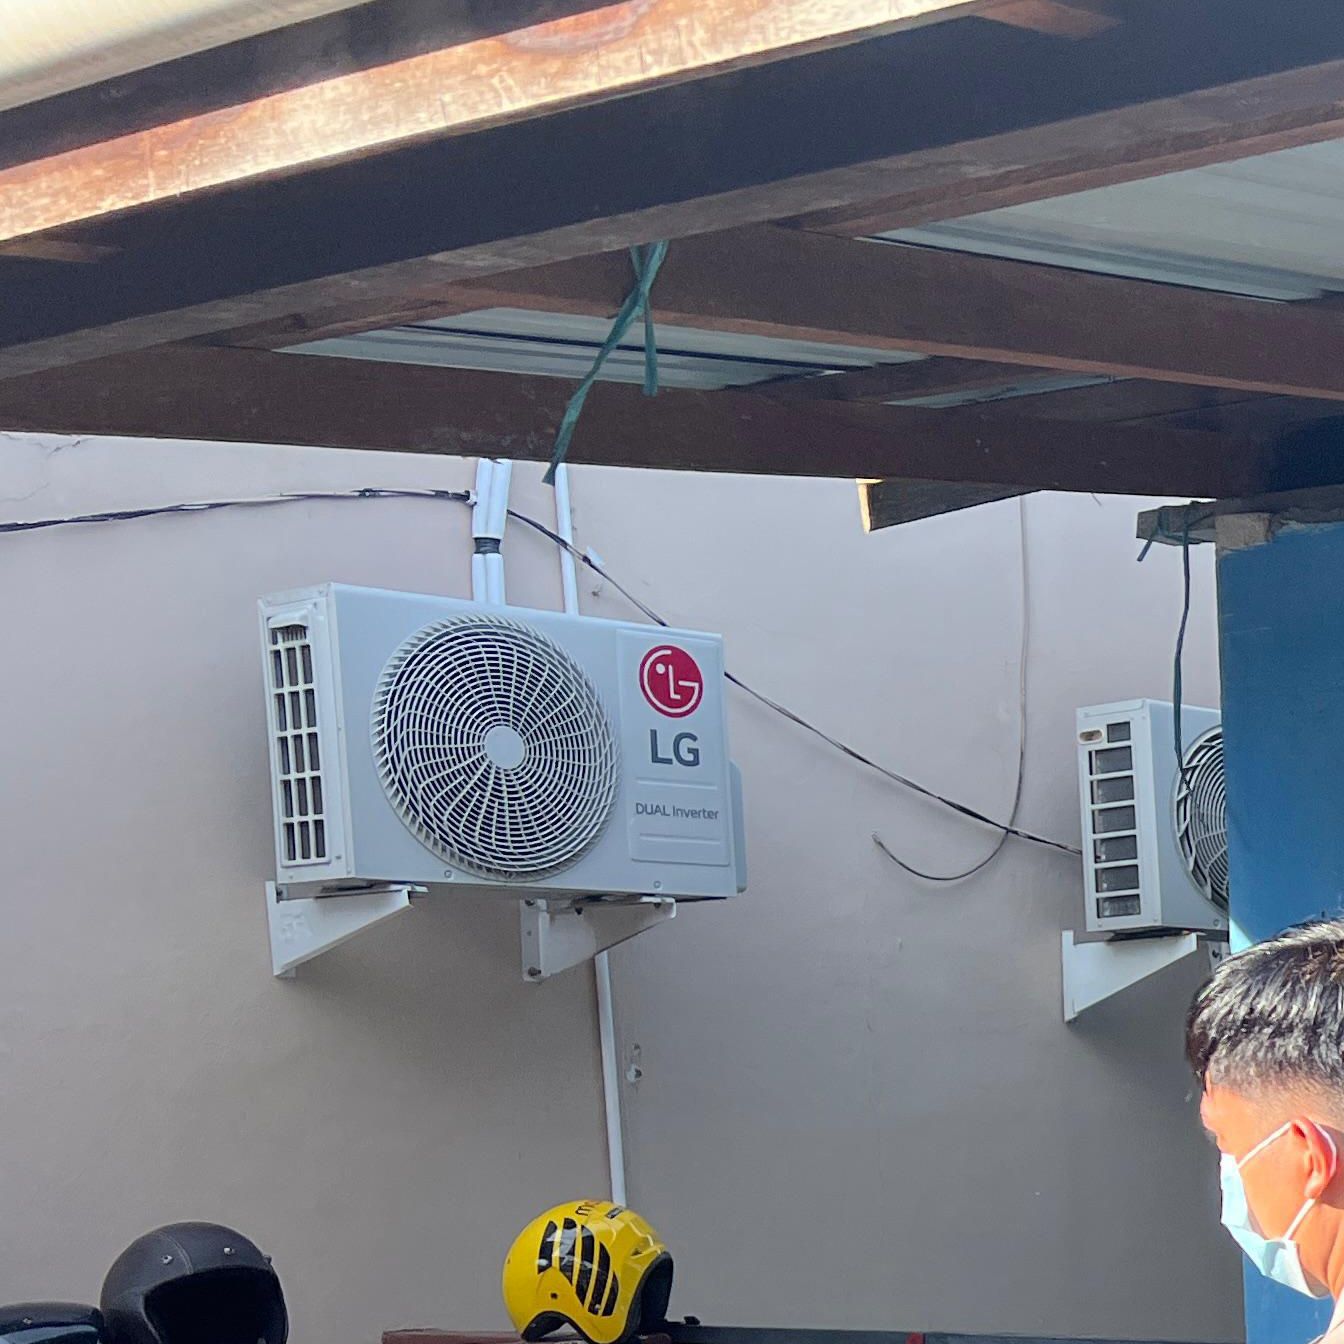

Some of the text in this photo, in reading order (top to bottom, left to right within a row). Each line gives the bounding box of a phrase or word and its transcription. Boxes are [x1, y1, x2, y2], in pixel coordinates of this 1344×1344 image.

[650, 729, 700, 767] LG
[636, 802, 719, 820] DUAL Inverter
